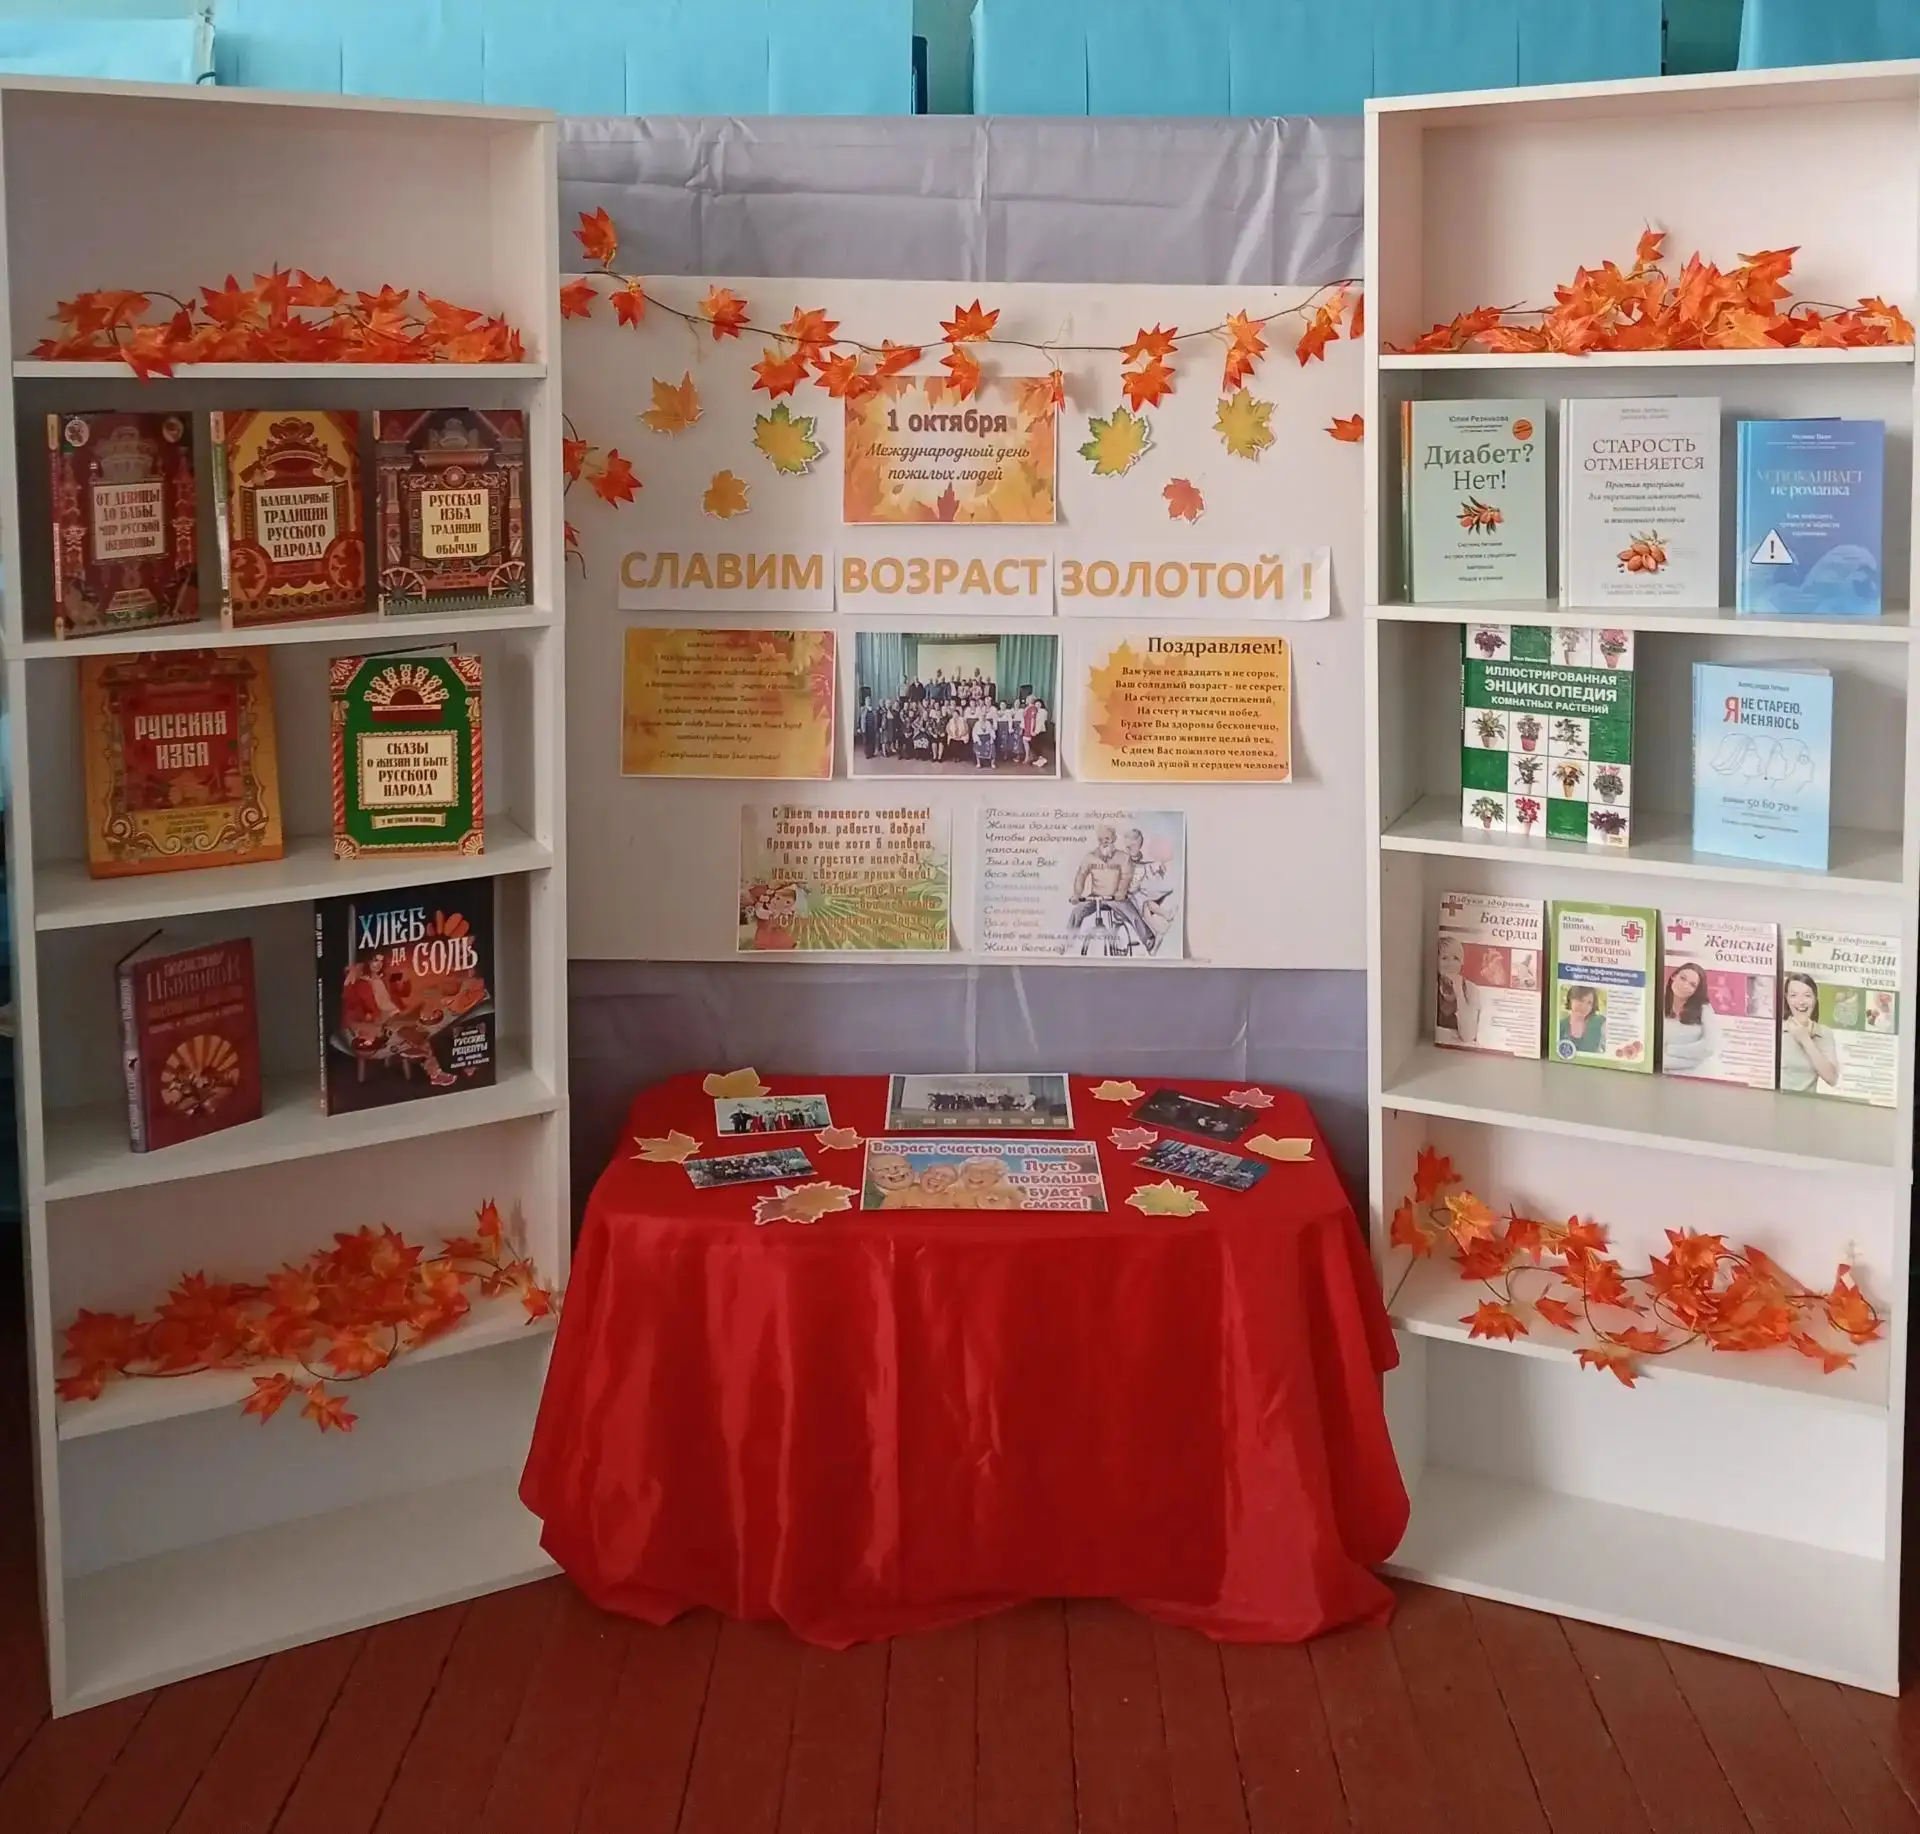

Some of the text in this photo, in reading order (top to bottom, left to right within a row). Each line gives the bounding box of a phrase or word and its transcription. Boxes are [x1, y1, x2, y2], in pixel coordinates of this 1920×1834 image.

[887, 409, 1007, 437] 1 октября
[866, 443, 1030, 462] Международный день
[1593, 438, 1696, 454] СТАРОСТЬ
[1424, 444, 1534, 470] Диабет?
[1584, 457, 1704, 471] ОТМЕНЯЕТСЯ
[888, 466, 1003, 485] пожилых людей
[1453, 470, 1506, 490] Нет!
[1790, 485, 1850, 499] ромашка
[96, 493, 110, 506] ОТ
[260, 492, 329, 507] КАЛЕНДАРНЫЕ
[429, 492, 481, 507] РУССКАЯ
[104, 508, 116, 521] ДО
[264, 507, 328, 524] ТРАДИЦИИ
[440, 507, 471, 521] ИЗБА
[267, 524, 326, 541] РУССКОГО
[431, 523, 482, 535] ТРАДИЦИИ
[273, 541, 322, 558] НАРОДА
[436, 543, 477, 555] ОБЫЧАИ
[620, 552, 1312, 601] СЛАВИМ ВОЗРАСТ ЗОЛОТОЙ !
[1148, 637, 1283, 658] Поздравляем!
[1122, 667, 1141, 676] Вам
[1142, 669, 1162, 678] уже
[1176, 669, 1222, 678] двадцать
[1485, 665, 1617, 686] ИЛЛЮСТРИРОВАННАЯ
[1116, 680, 1136, 689] Ваш
[1137, 681, 1187, 690] солидный
[1189, 683, 1227, 691] возраст
[1485, 679, 1617, 702] ЭНЦИКЛОПЕДИЯ
[1124, 693, 1138, 701] На
[1139, 694, 1166, 702] счету
[1168, 695, 1208, 703] десятки
[1491, 696, 1609, 714] КОМНАТНЫХ РАСТЕНИЙ
[1137, 707, 1151, 715] На
[1153, 708, 1179, 717] счету
[1190, 709, 1228, 717] тысячи
[1723, 696, 1802, 724] Я НЕ СТАРЕЮ,
[134, 710, 227, 740] РУССКАЯ
[1121, 719, 1153, 730] Будьте
[1155, 720, 1170, 729] Вы
[1171, 722, 1214, 731] здоровы
[1741, 713, 1799, 730] МЕНЯЮСЬ
[1125, 733, 1177, 742] Счастливо
[1179, 735, 1217, 743] живите
[1218, 735, 1251, 744] целый
[156, 741, 209, 770] ИЗБА
[387, 742, 429, 756] СКАЗЫ
[1129, 748, 1154, 756] днем
[1157, 747, 1174, 756] Вас
[1175, 749, 1226, 757] пожилого
[367, 757, 449, 768] О ЖИЗНИ И БЫТЕ
[1111, 759, 1155, 768] Молодой
[1157, 760, 1190, 770] душой
[1200, 762, 1242, 771] сердцем
[378, 769, 438, 783] РУССКОГО
[383, 784, 433, 797] НАРОДА
[1748, 799, 1759, 808] 50
[772, 808, 779, 819] С
[784, 808, 812, 819] Днем
[818, 808, 870, 819] пожилого
[890, 823, 926, 836] добра!
[985, 832, 1025, 843] Чтобы
[819, 840, 840, 851] еще
[846, 840, 871, 850] хотя
[796, 855, 808, 865] не
[1480, 912, 1539, 927] Болезни
[358, 906, 426, 950] ХЛЕБ
[1492, 928, 1538, 941] сердца
[1704, 934, 1774, 952] Женские
[391, 936, 478, 977] ДА СОЛЬ
[1715, 949, 1773, 966] болезни
[1830, 948, 1897, 966] Болезни
[1792, 959, 1897, 976] пищеварительного
[1861, 976, 1896, 988] тракта
[872, 1142, 1093, 1155] Возраст счастью не помеха!
[1024, 1160, 1080, 1173] Пусть
[1008, 1174, 1098, 1184] побольше
[1030, 1188, 1080, 1200] будет
[1024, 1199, 1089, 1210] смеха!
